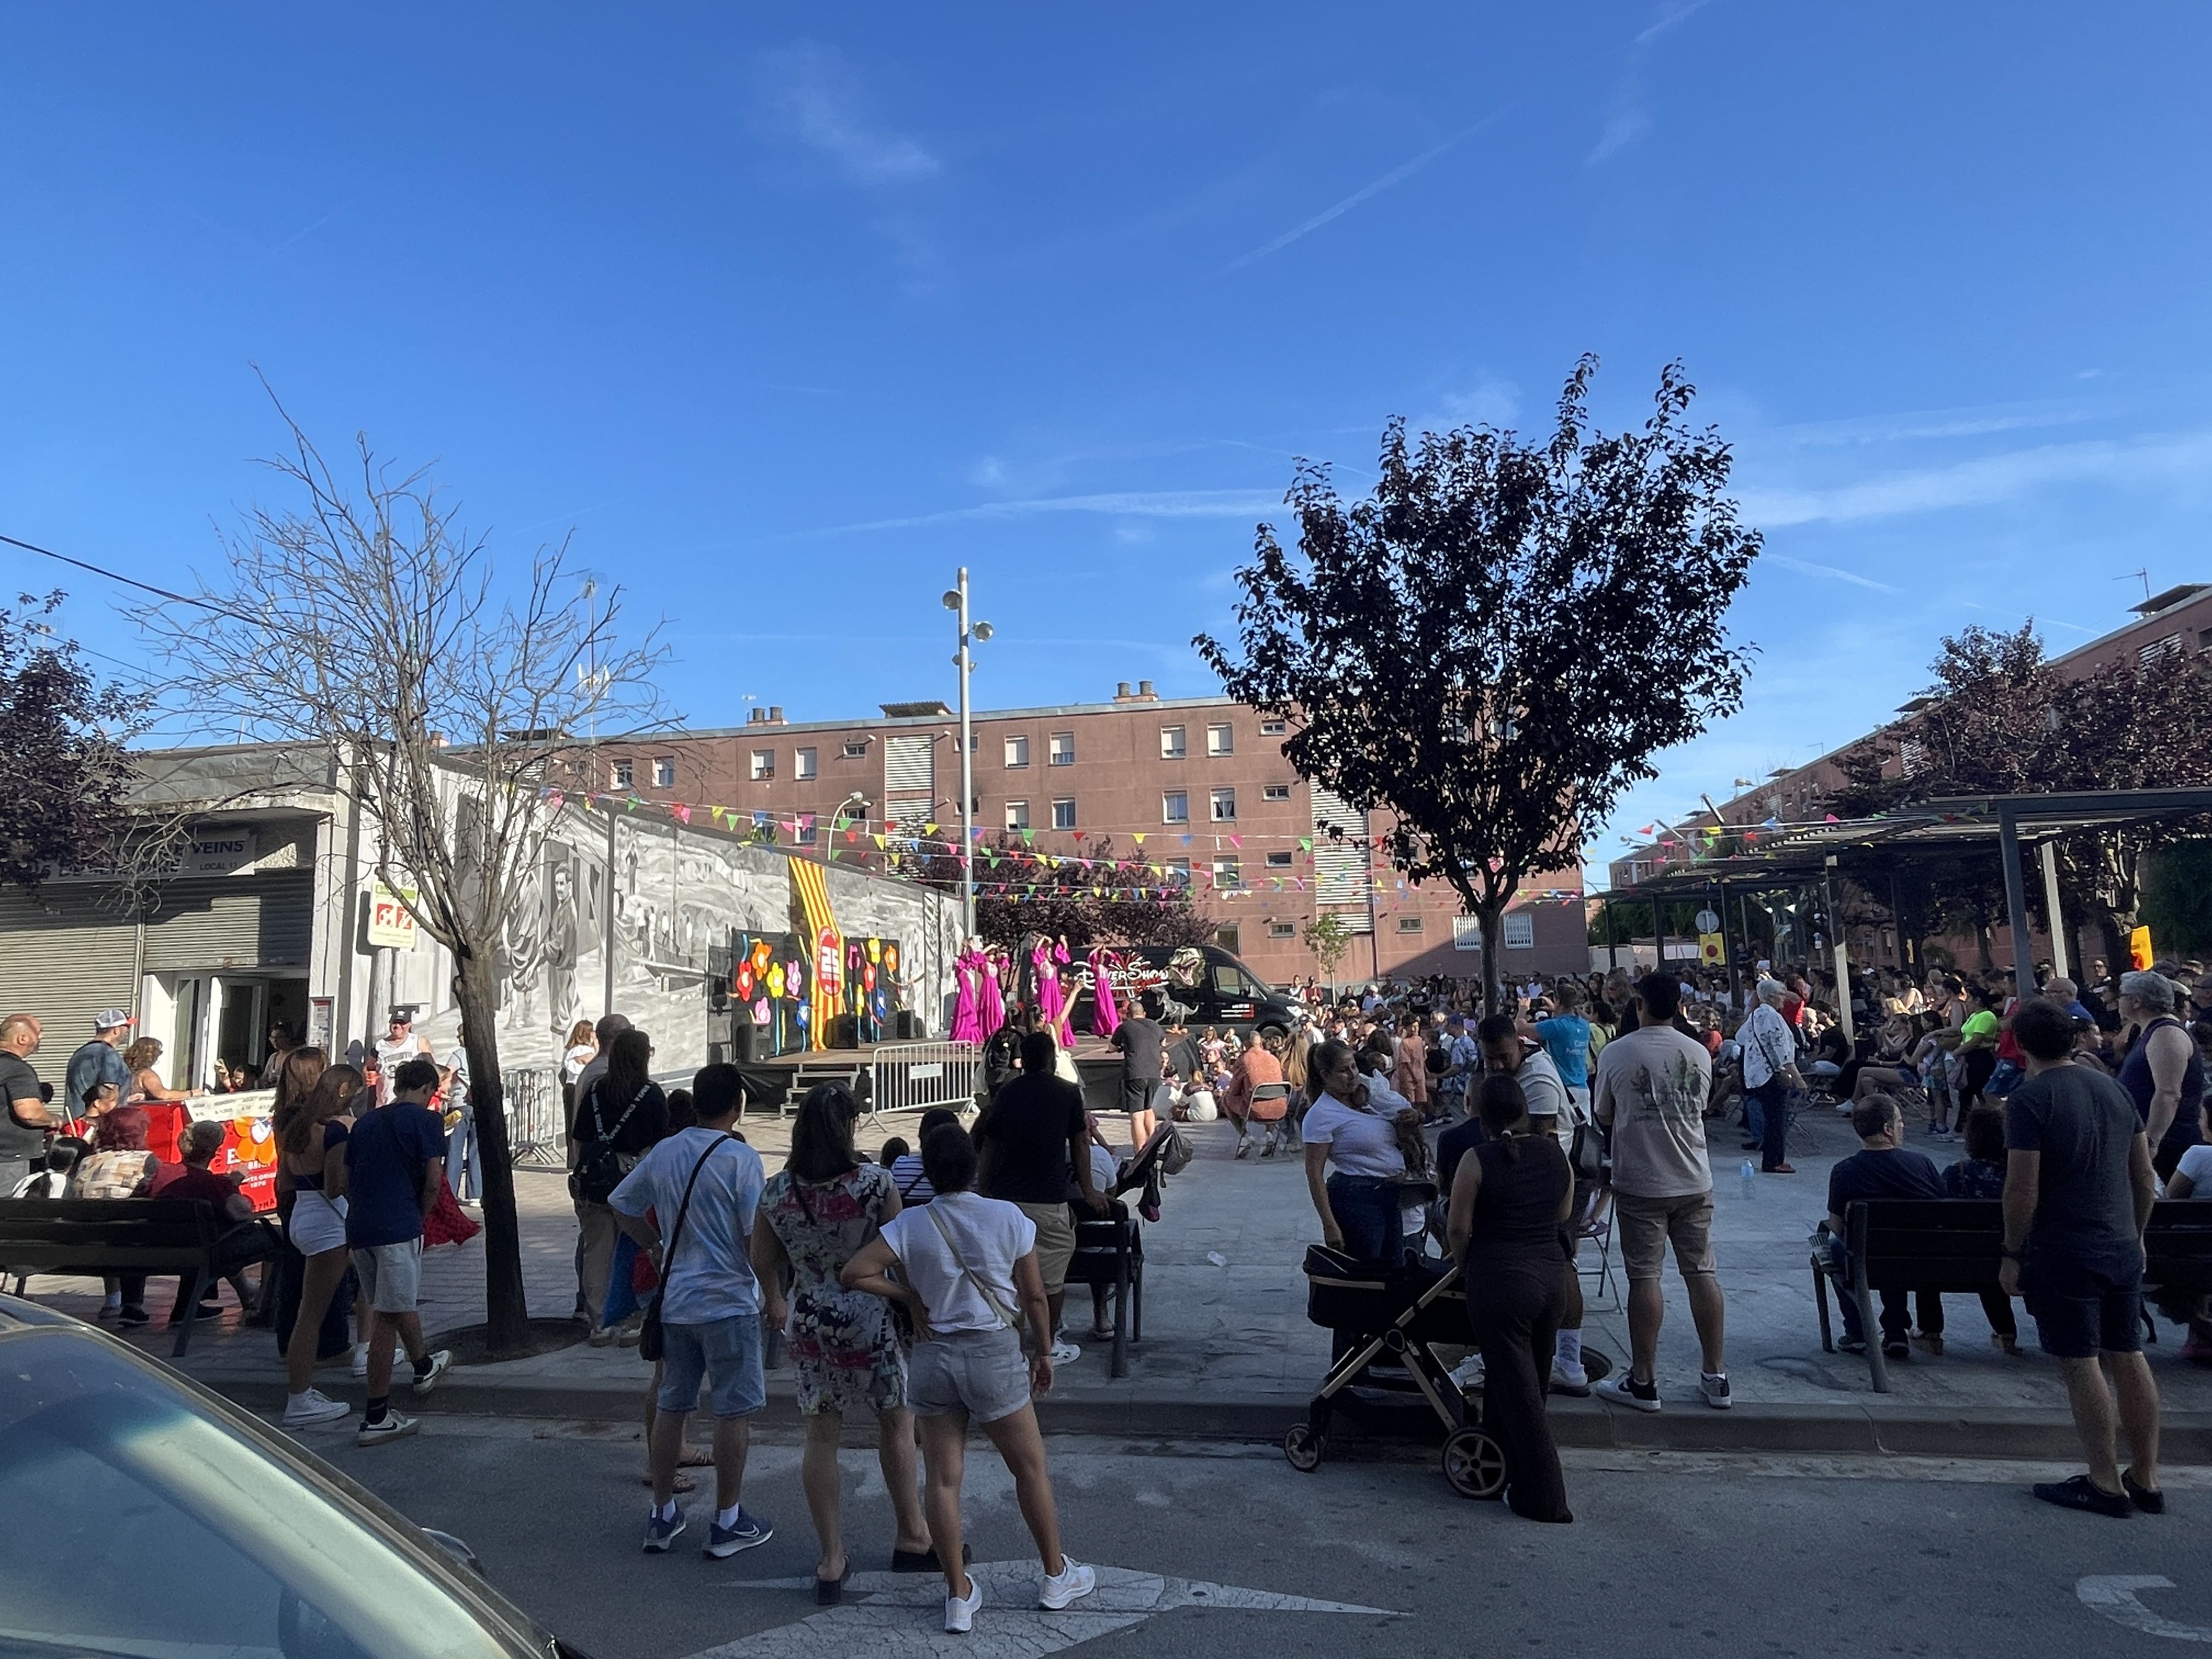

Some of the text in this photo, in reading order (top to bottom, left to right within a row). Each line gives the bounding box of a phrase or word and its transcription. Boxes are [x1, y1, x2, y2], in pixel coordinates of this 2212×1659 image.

[192, 840, 245, 854] VEINS
[199, 862, 227, 871] LOCAL
[821, 945, 840, 974] 25
[1073, 961, 1169, 990] DERSHOW
